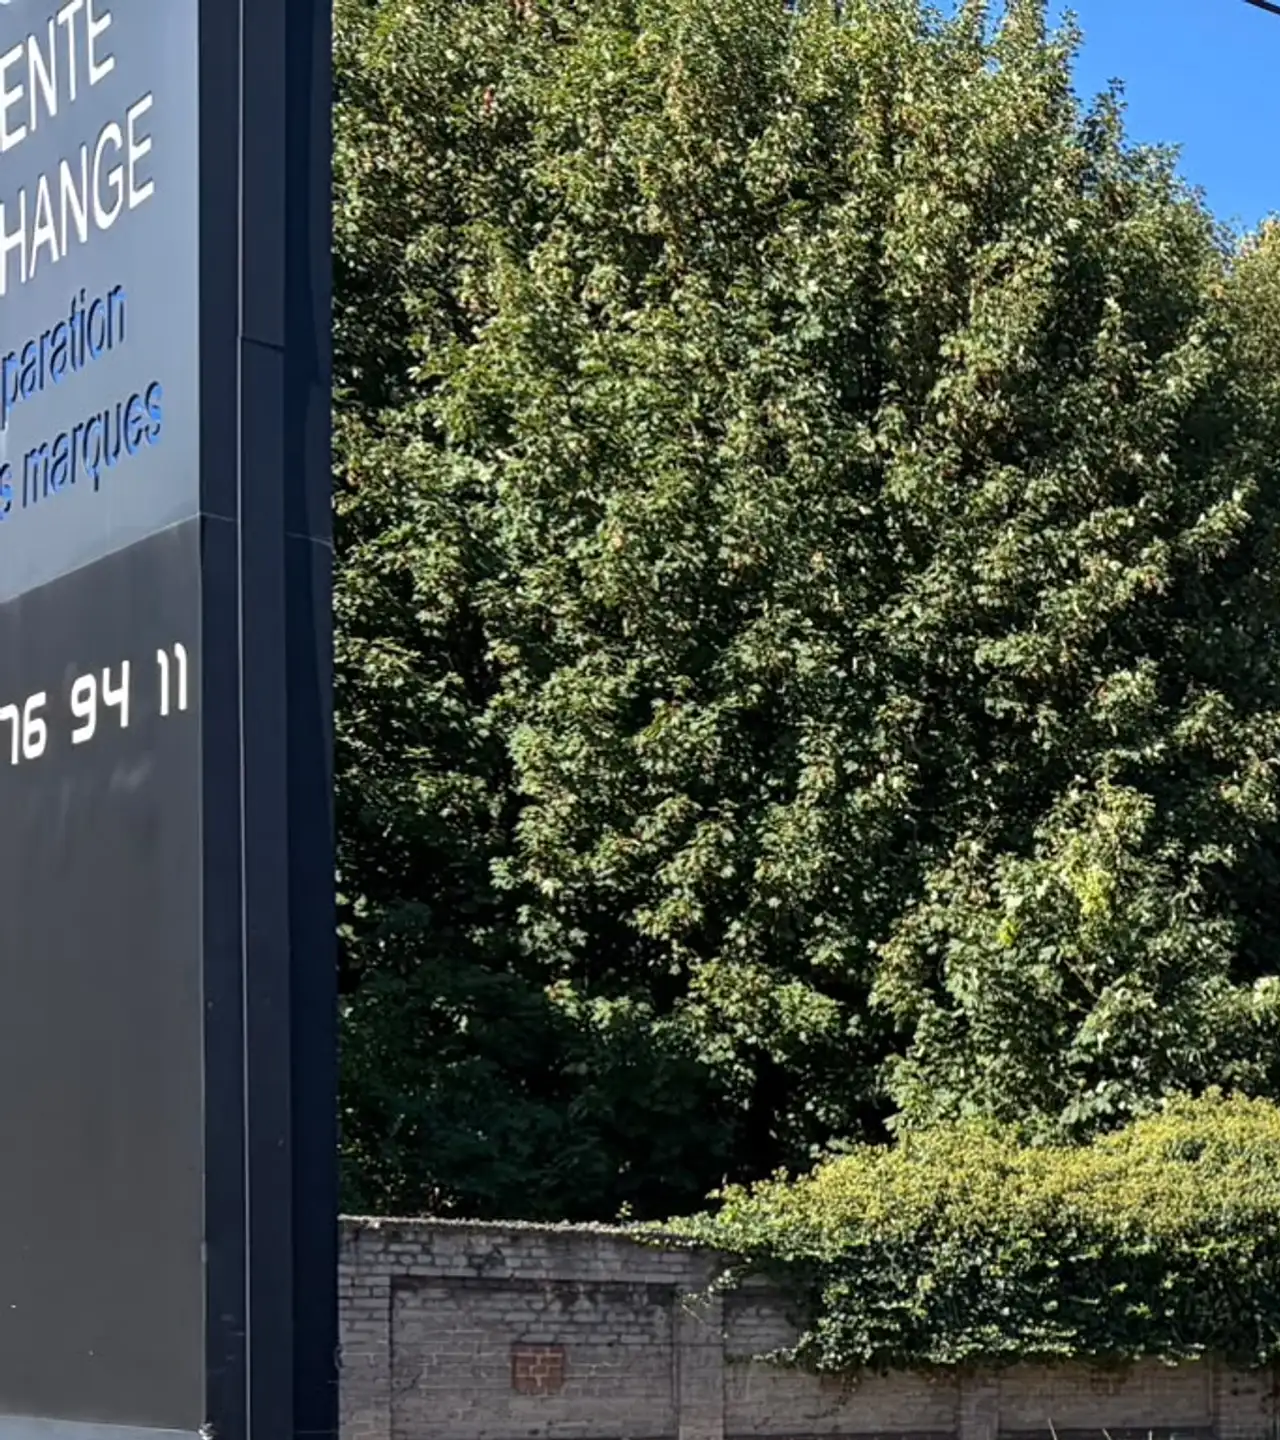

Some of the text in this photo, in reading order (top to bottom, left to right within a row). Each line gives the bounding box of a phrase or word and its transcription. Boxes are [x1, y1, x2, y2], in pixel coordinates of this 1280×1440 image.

[0, 94, 155, 297] HANGE
[1, 284, 127, 432] paration
[22, 381, 163, 508] marques
[71, 660, 130, 744] 94
[156, 642, 188, 716] 11
